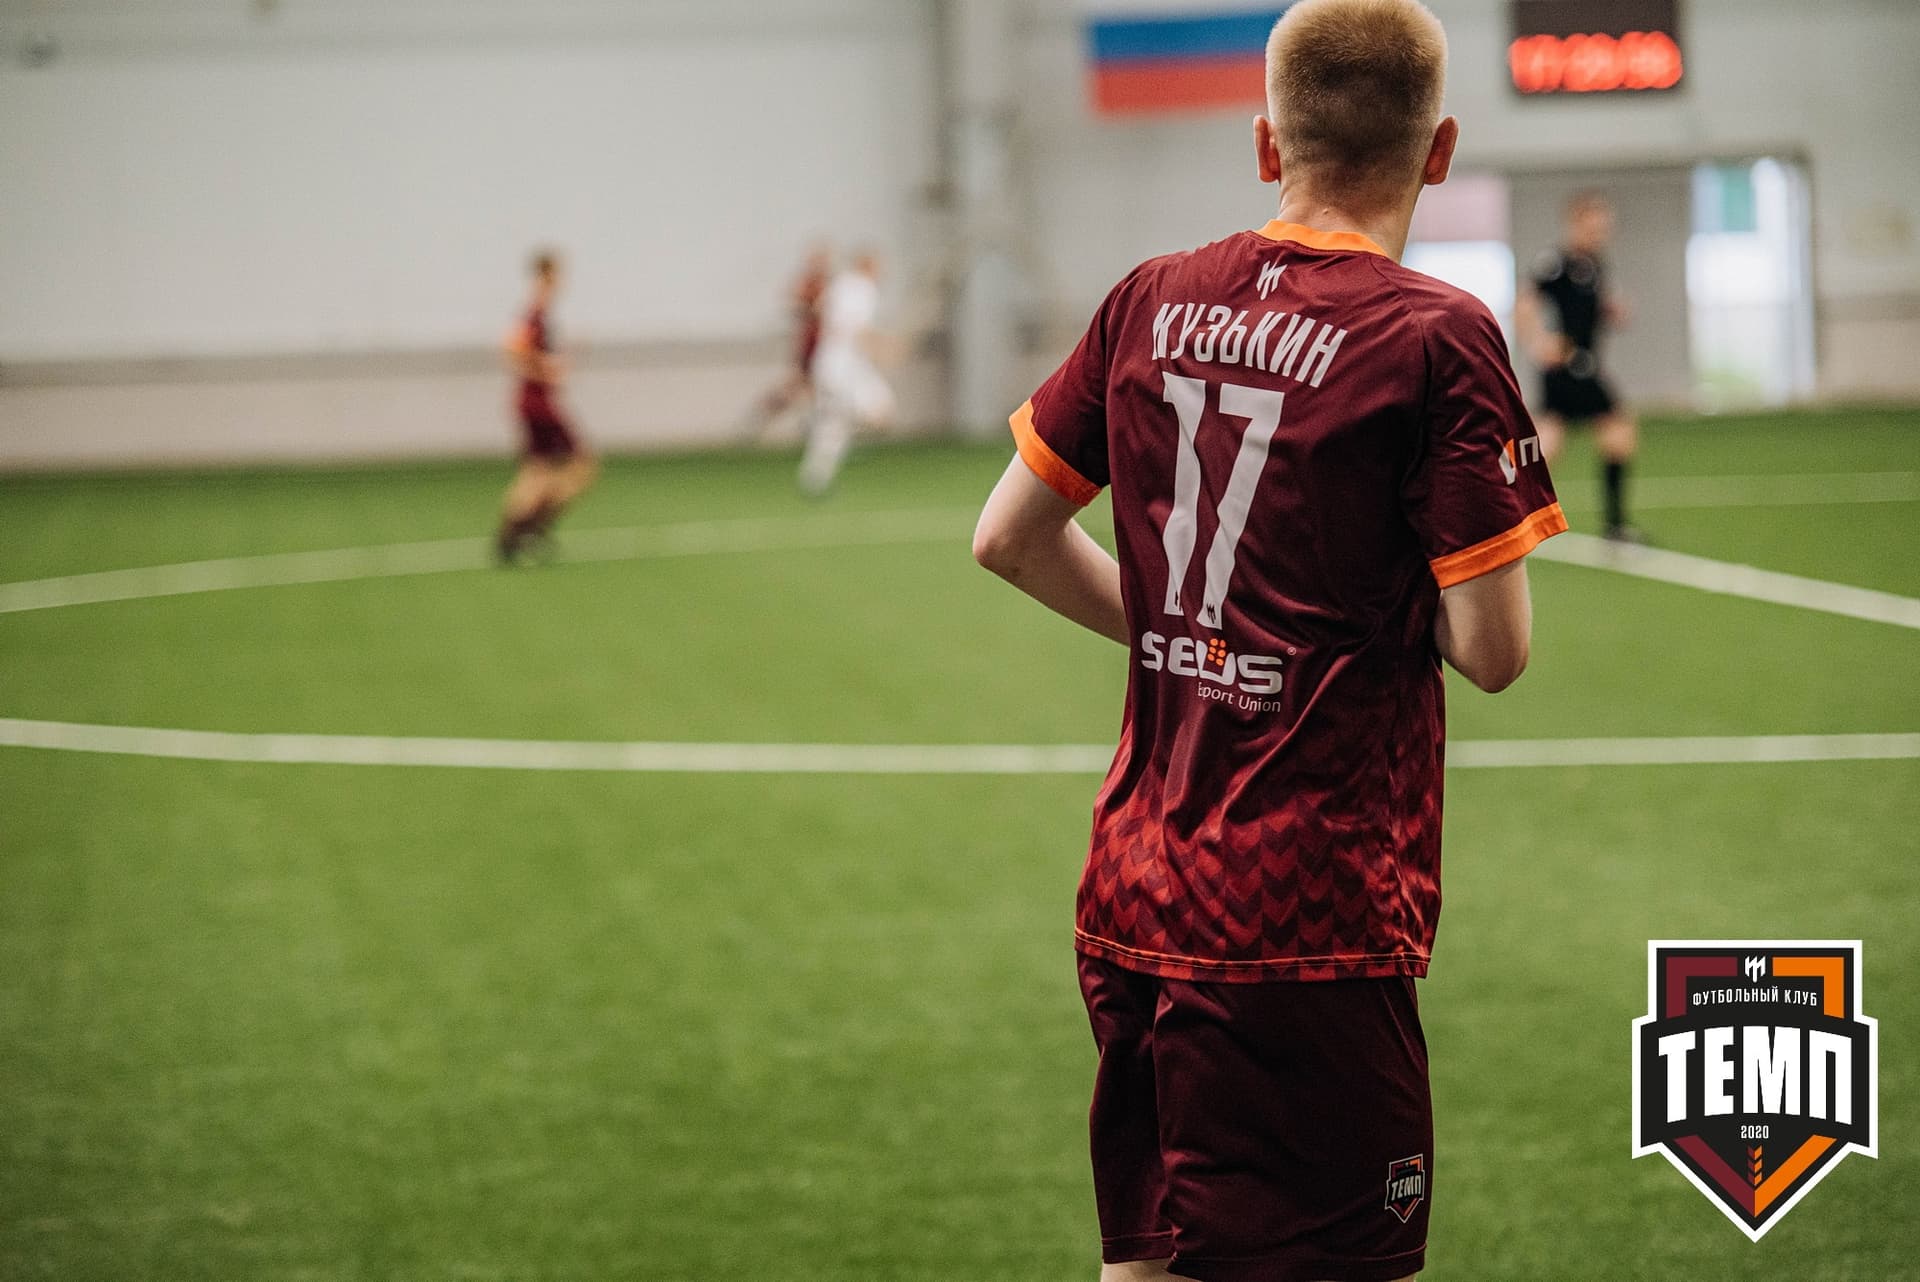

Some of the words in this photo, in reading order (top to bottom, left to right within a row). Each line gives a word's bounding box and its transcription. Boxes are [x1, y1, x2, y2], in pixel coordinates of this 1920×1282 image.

[1152, 302, 1348, 388] КУЗЬКИН
[1162, 371, 1284, 631] 17
[1239, 695, 1281, 712] Union
[1391, 1175, 1422, 1201] ТЕМП
